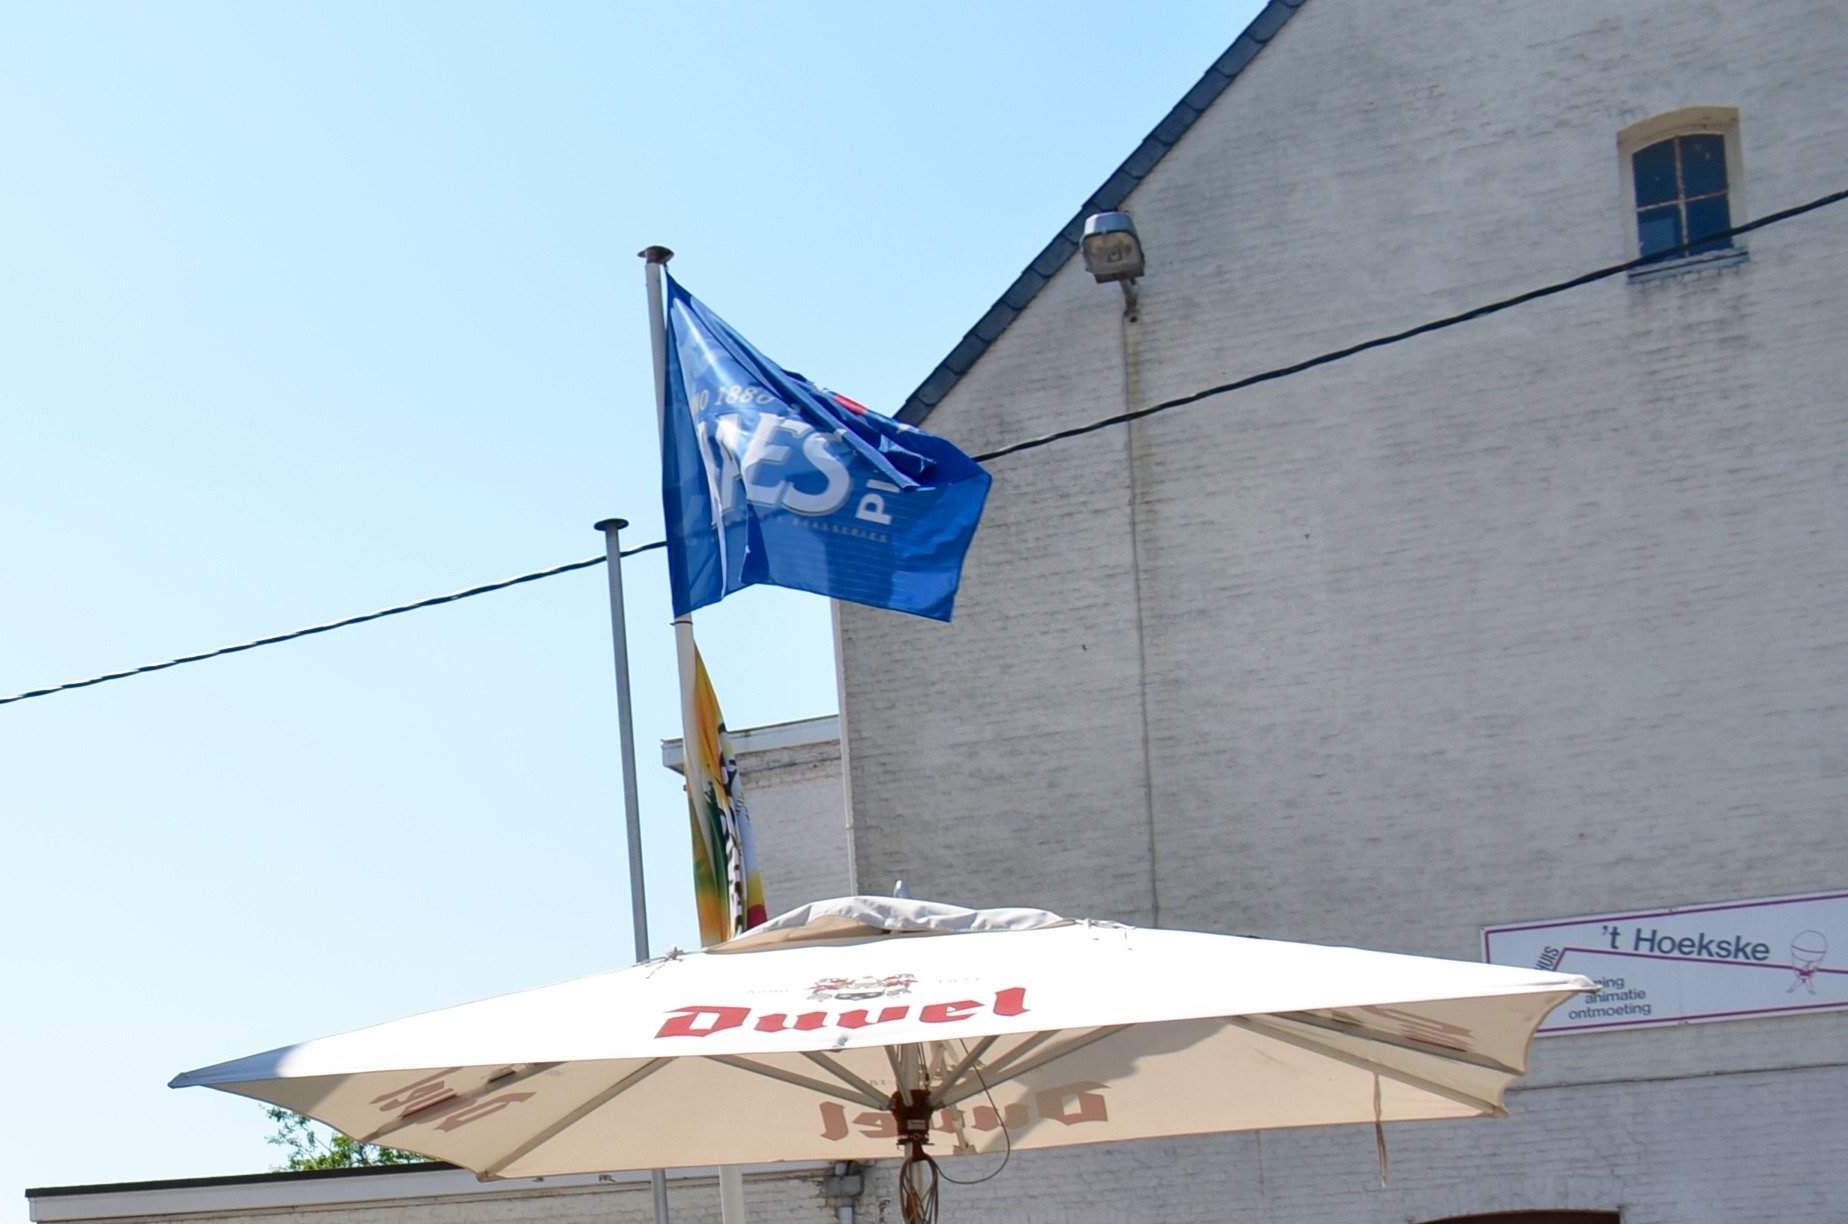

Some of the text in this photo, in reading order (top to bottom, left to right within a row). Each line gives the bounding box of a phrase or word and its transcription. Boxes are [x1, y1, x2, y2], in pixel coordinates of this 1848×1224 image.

[1633, 928, 1770, 962] Hoekske
[1584, 989, 1647, 1005] animatie
[654, 986, 1032, 1040] Duvel
[1568, 1002, 1651, 1019] ontmoeting
